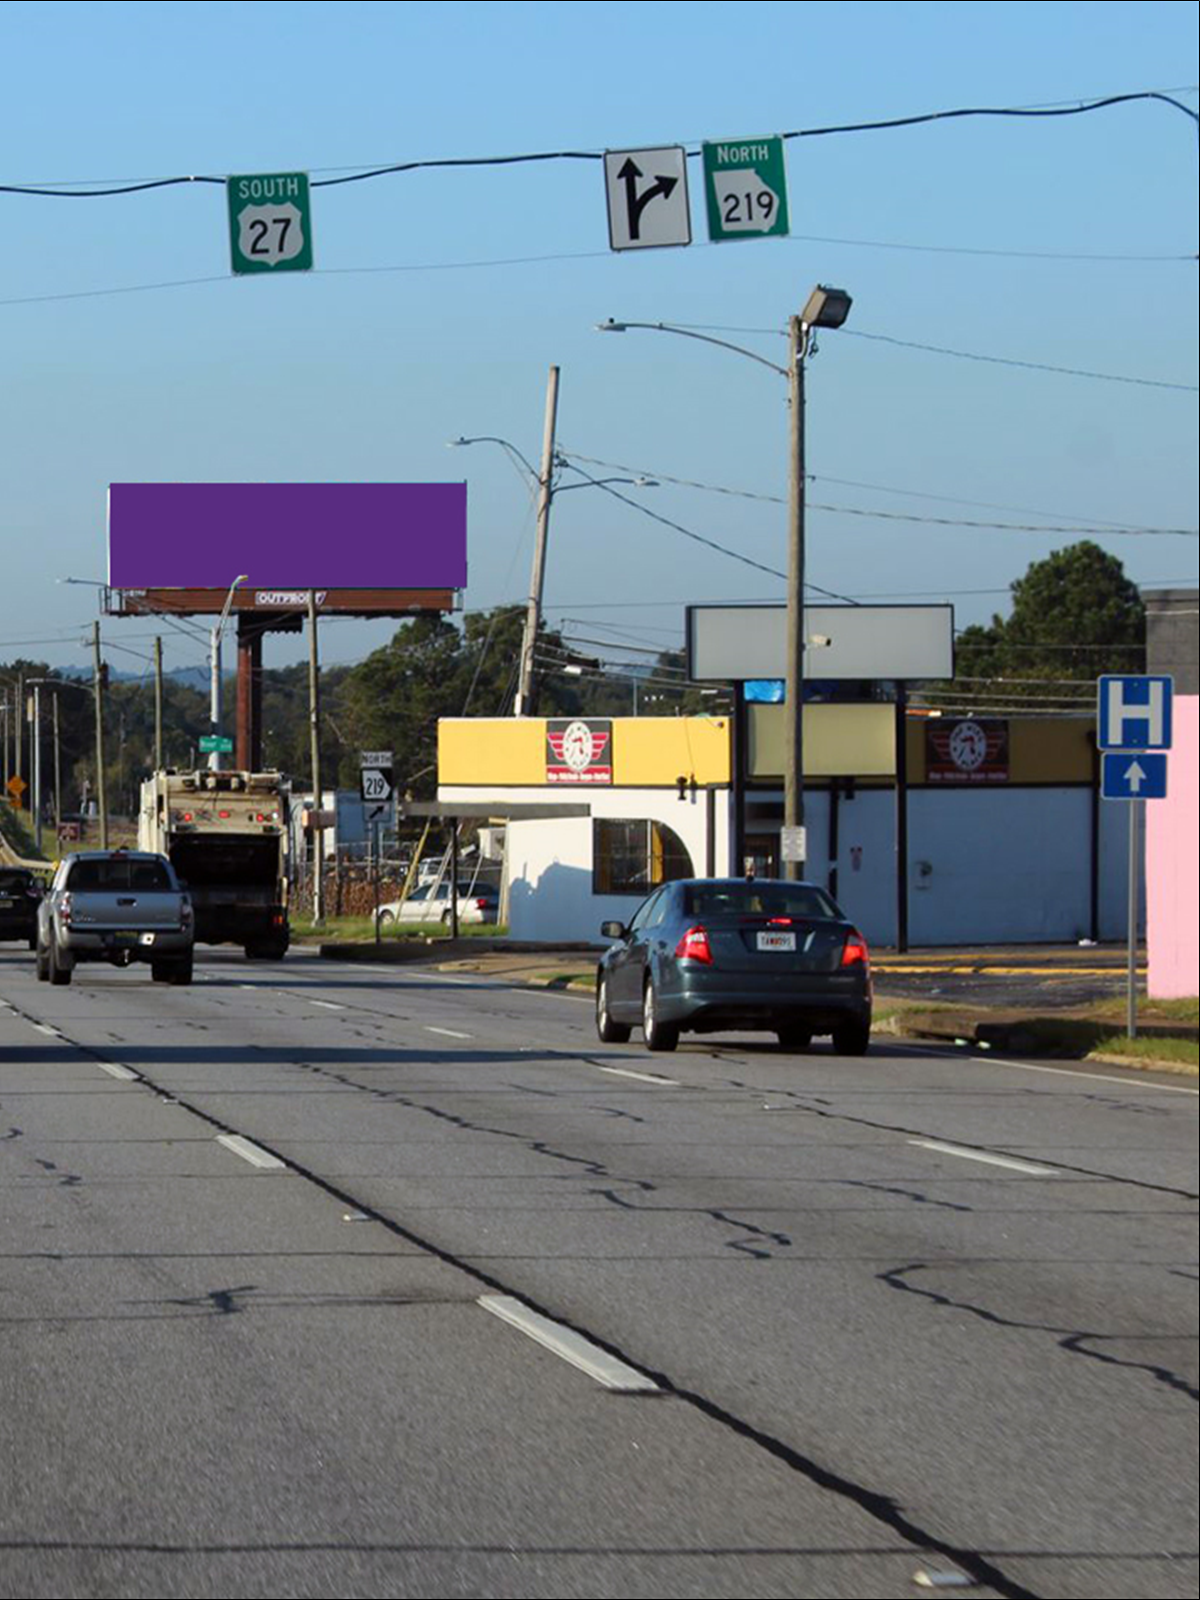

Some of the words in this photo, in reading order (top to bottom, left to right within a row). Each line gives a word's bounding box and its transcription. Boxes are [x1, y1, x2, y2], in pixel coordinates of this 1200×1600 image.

[717, 145, 769, 164] NORTH
[239, 177, 299, 199] SOUTH
[723, 191, 774, 223] 219
[249, 218, 291, 254] 27
[1108, 681, 1163, 745] H
[366, 778, 386, 796] 219
